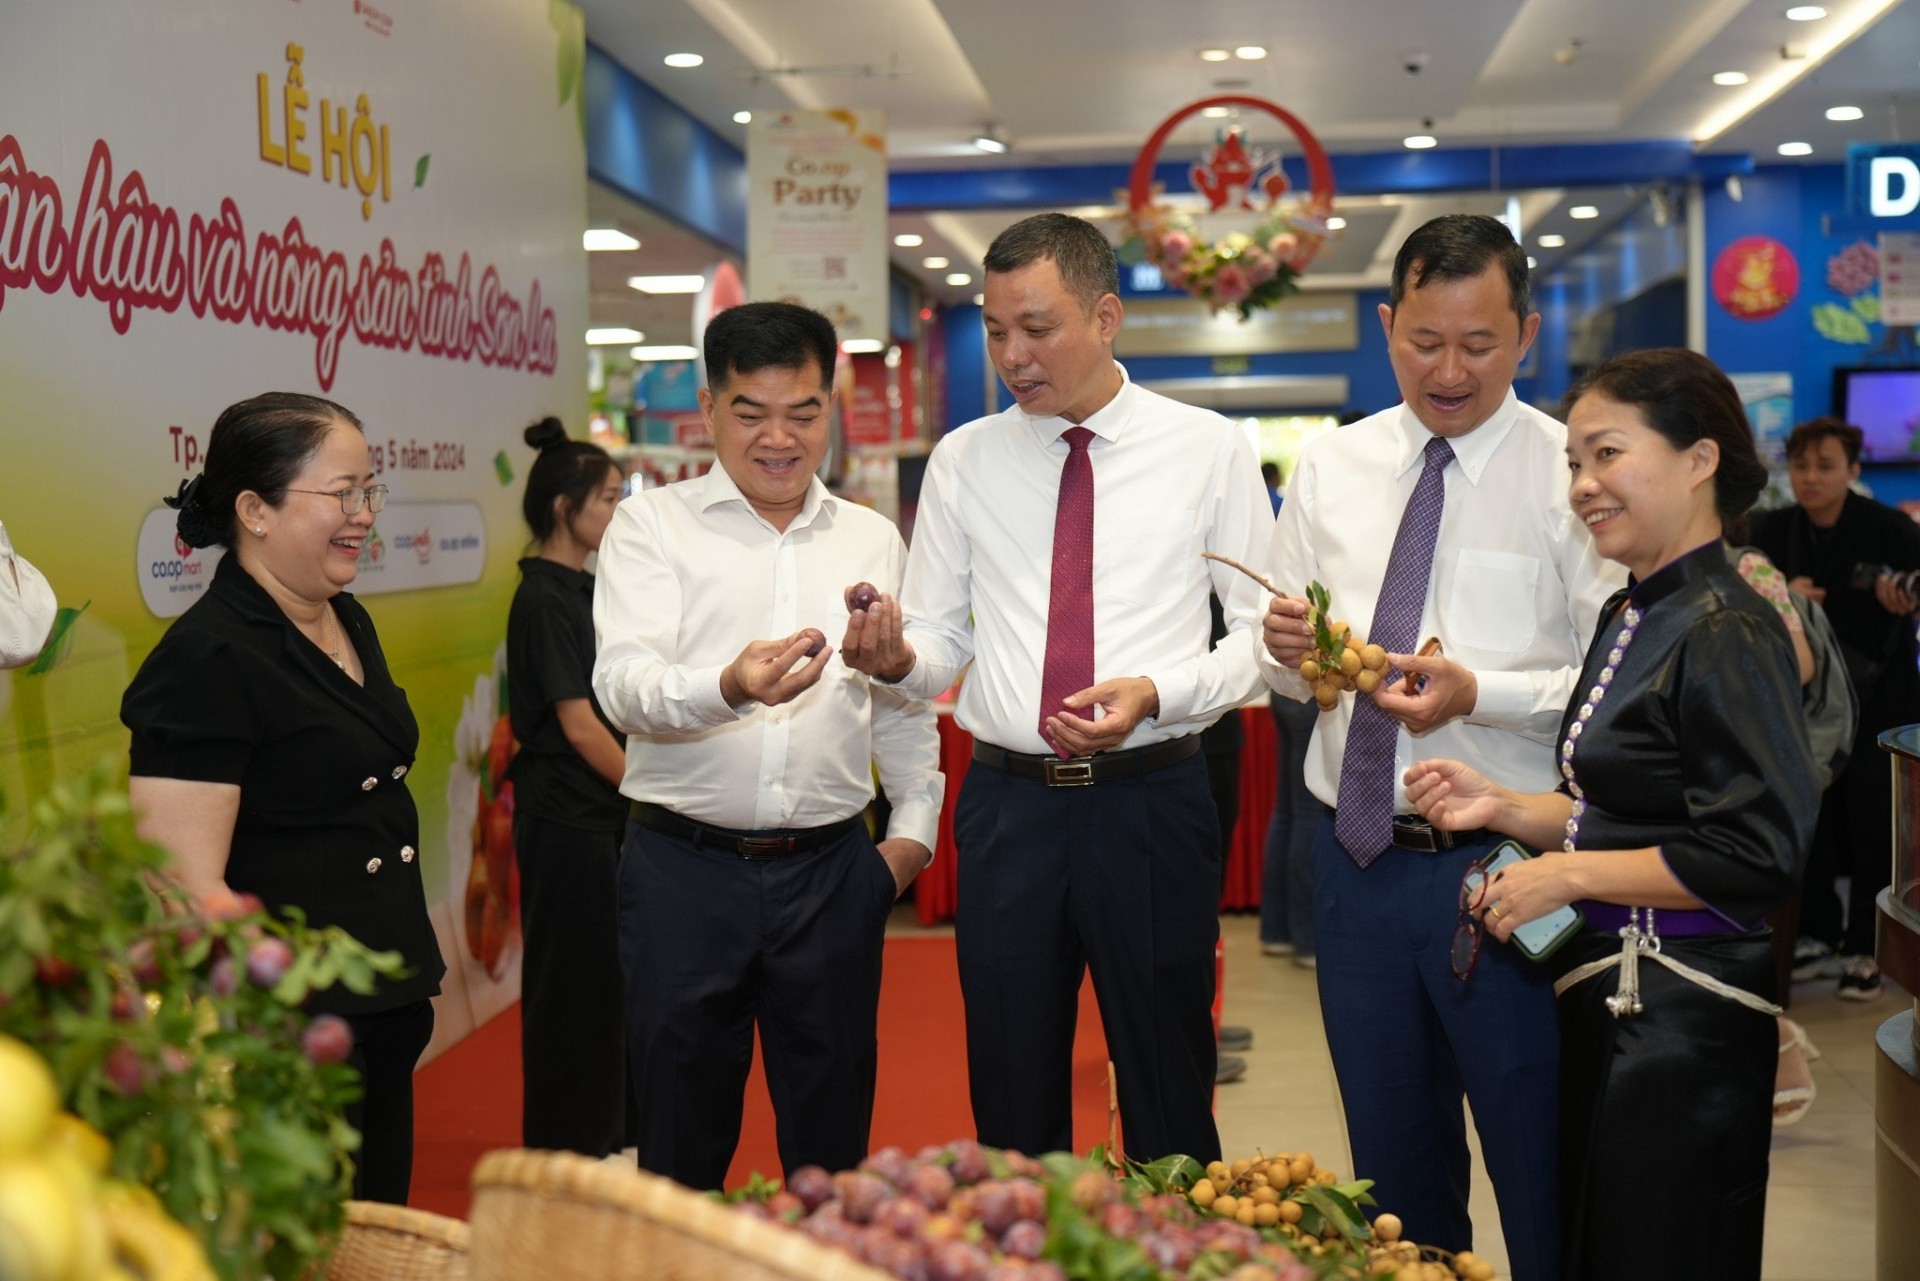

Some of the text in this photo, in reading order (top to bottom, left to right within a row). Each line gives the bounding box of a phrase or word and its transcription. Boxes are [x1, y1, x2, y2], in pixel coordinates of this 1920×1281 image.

[258, 42, 391, 221] LỄ HỘI
[772, 179, 862, 210] Party
[70, 142, 185, 333] hậu
[188, 198, 249, 321] và
[251, 218, 350, 390] nông
[352, 238, 416, 351] sản
[418, 252, 475, 360] tỉnh
[526, 278, 557, 375] La
[169, 427, 203, 470] Tp.
[388, 440, 398, 469] 5
[402, 439, 430, 470] năm
[434, 442, 465, 470] 2024
